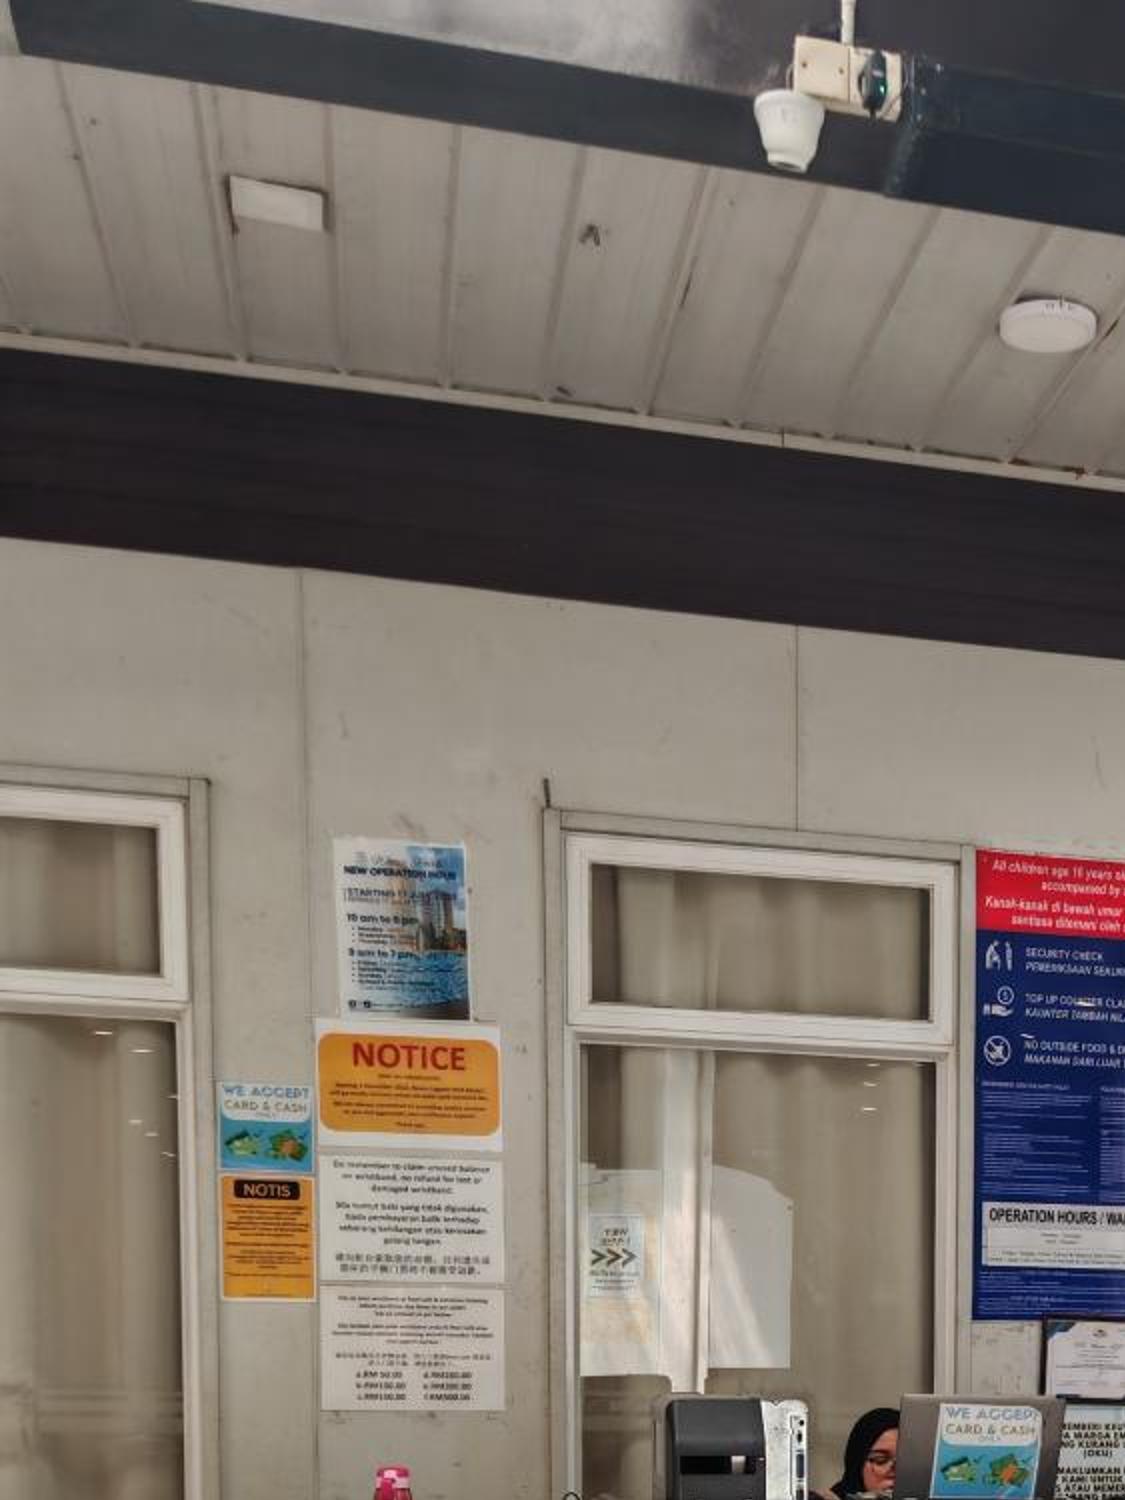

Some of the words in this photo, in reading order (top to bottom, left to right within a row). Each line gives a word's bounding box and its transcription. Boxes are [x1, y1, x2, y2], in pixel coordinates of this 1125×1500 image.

[352, 1043, 465, 1070] NOTICE
[224, 1086, 248, 1098] WE
[224, 1100, 260, 1110] CARD
[275, 1102, 307, 1112] CASH
[243, 1183, 290, 1197] NOTIS
[989, 1208, 1051, 1222] OPERATION
[1057, 1211, 1097, 1224] HOURS
[946, 1408, 970, 1418] WE
[945, 1425, 983, 1434] CARD
[1000, 1426, 1035, 1436] CASH
